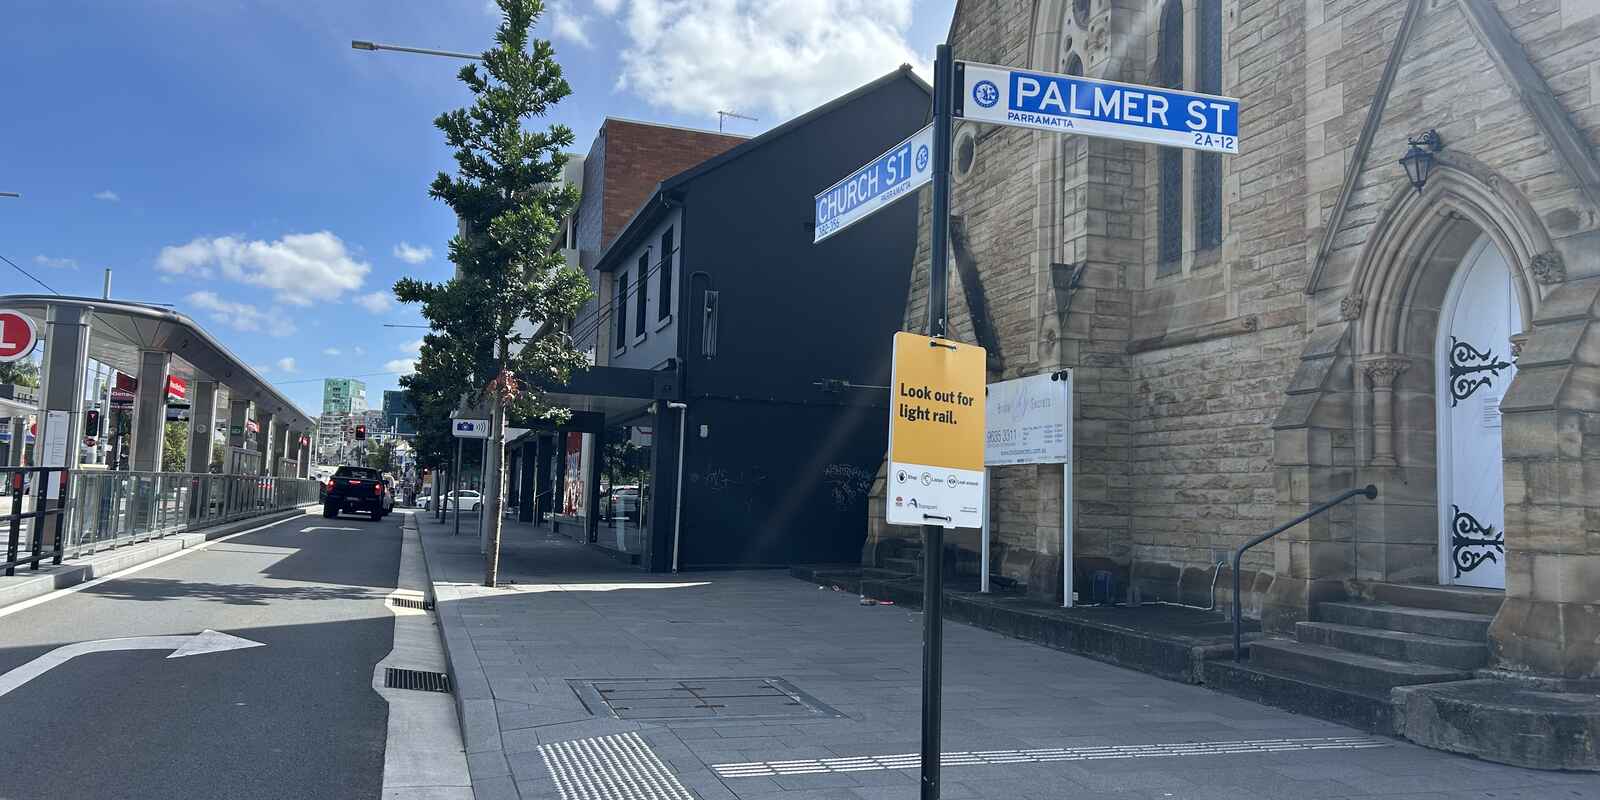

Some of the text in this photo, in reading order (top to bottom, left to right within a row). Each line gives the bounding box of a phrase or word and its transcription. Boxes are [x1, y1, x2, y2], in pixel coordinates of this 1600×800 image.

[1016, 76, 1230, 133] PALMER ST
[1008, 112, 1073, 128] PARRAMATTA
[1194, 133, 1234, 149] 2A-12
[819, 147, 908, 223] CHURCH ST
[881, 181, 911, 201] PARRAMATTA
[901, 382, 974, 406] Look out for
[900, 403, 957, 425] light rail.
